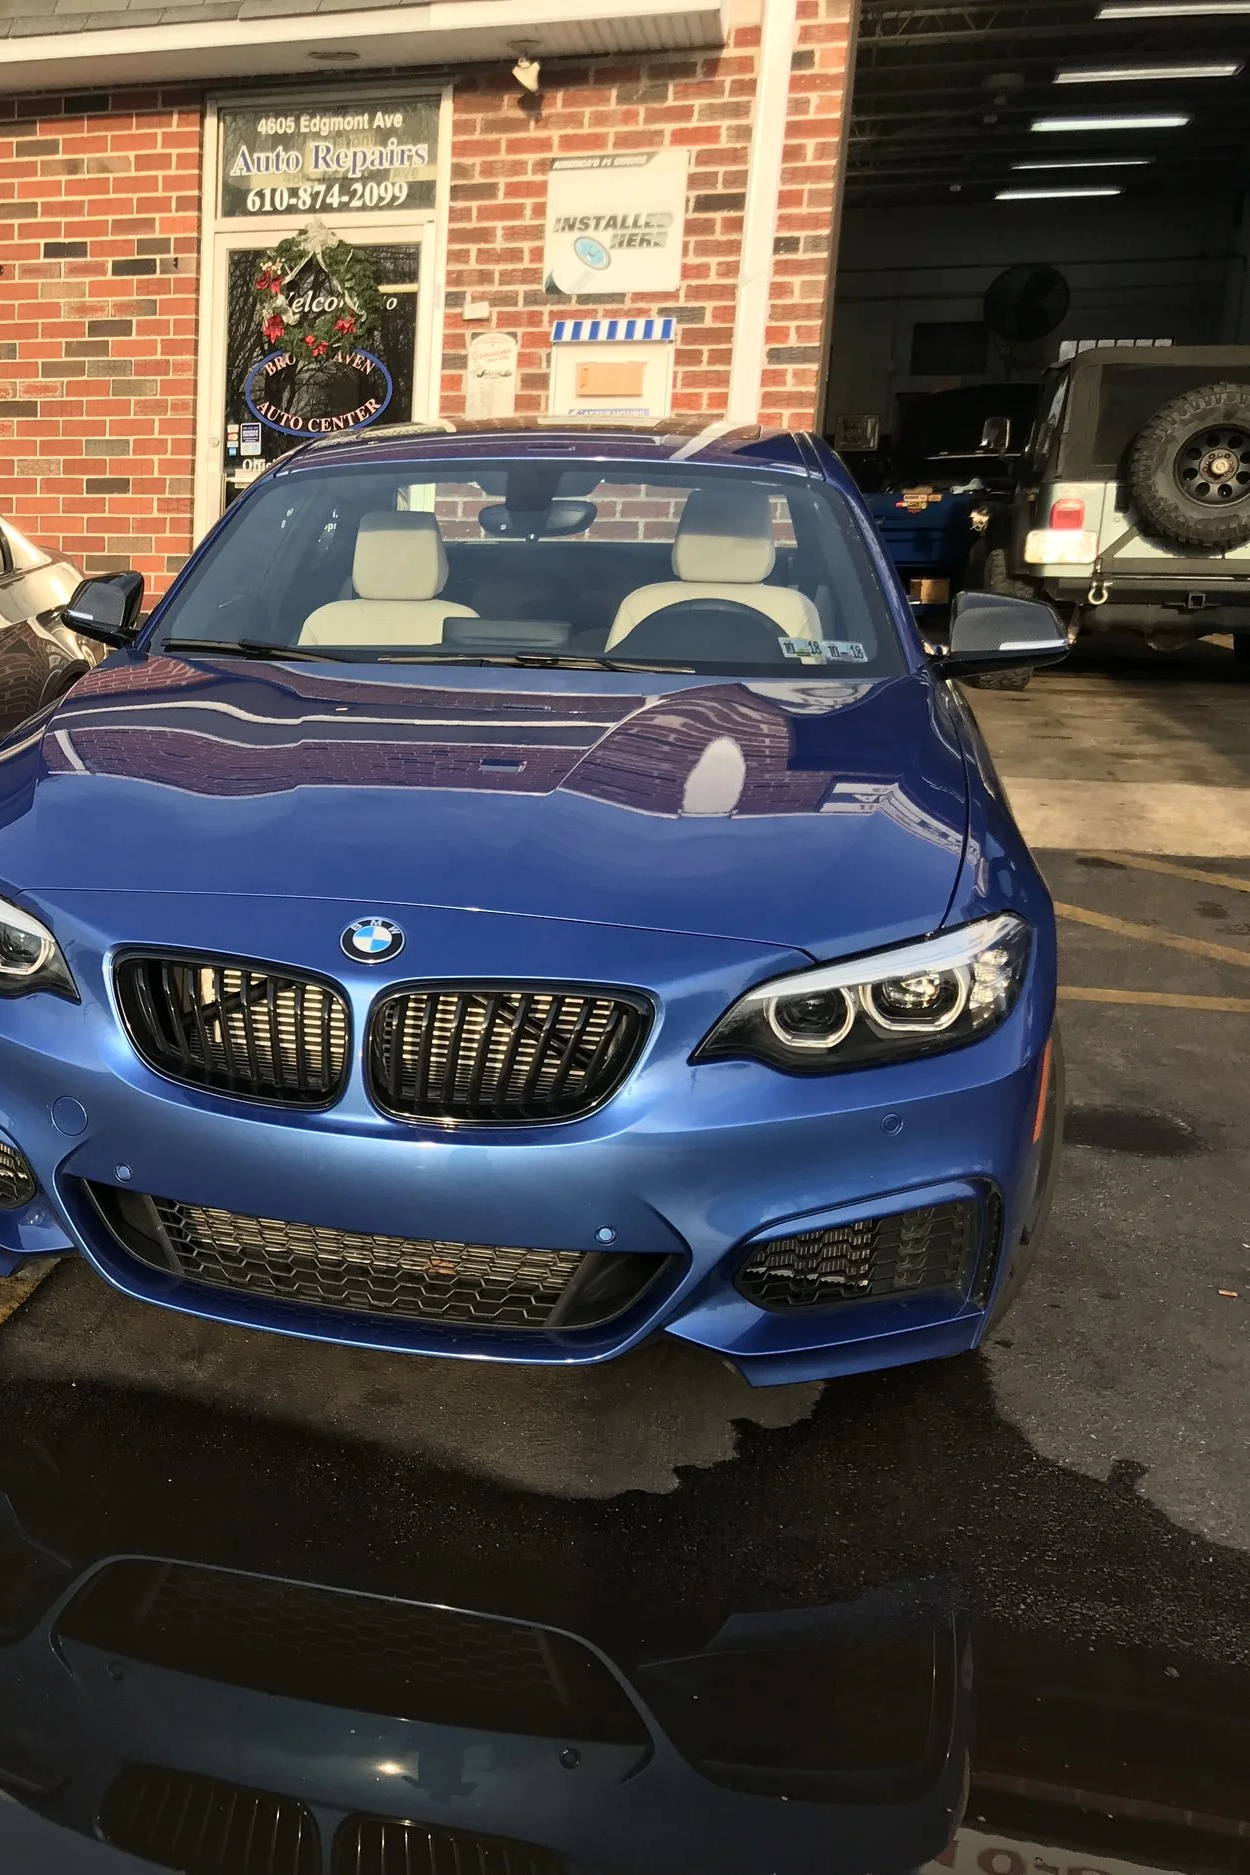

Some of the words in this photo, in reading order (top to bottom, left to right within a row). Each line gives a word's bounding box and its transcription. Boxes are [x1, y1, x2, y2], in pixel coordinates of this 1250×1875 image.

[258, 117, 295, 135] 4605
[300, 113, 369, 136] Edgmont
[373, 111, 403, 129] Ave
[230, 145, 302, 176] Auto
[309, 137, 429, 178] Repairs
[246, 180, 409, 212] 610-874-2099
[263, 351, 376, 377] BROAVEN
[257, 401, 303, 431] AUTO
[307, 398, 382, 432] CENTER
[808, 641, 822, 655] 18
[850, 645, 864, 659] 18
[351, 920, 401, 934] BMW
